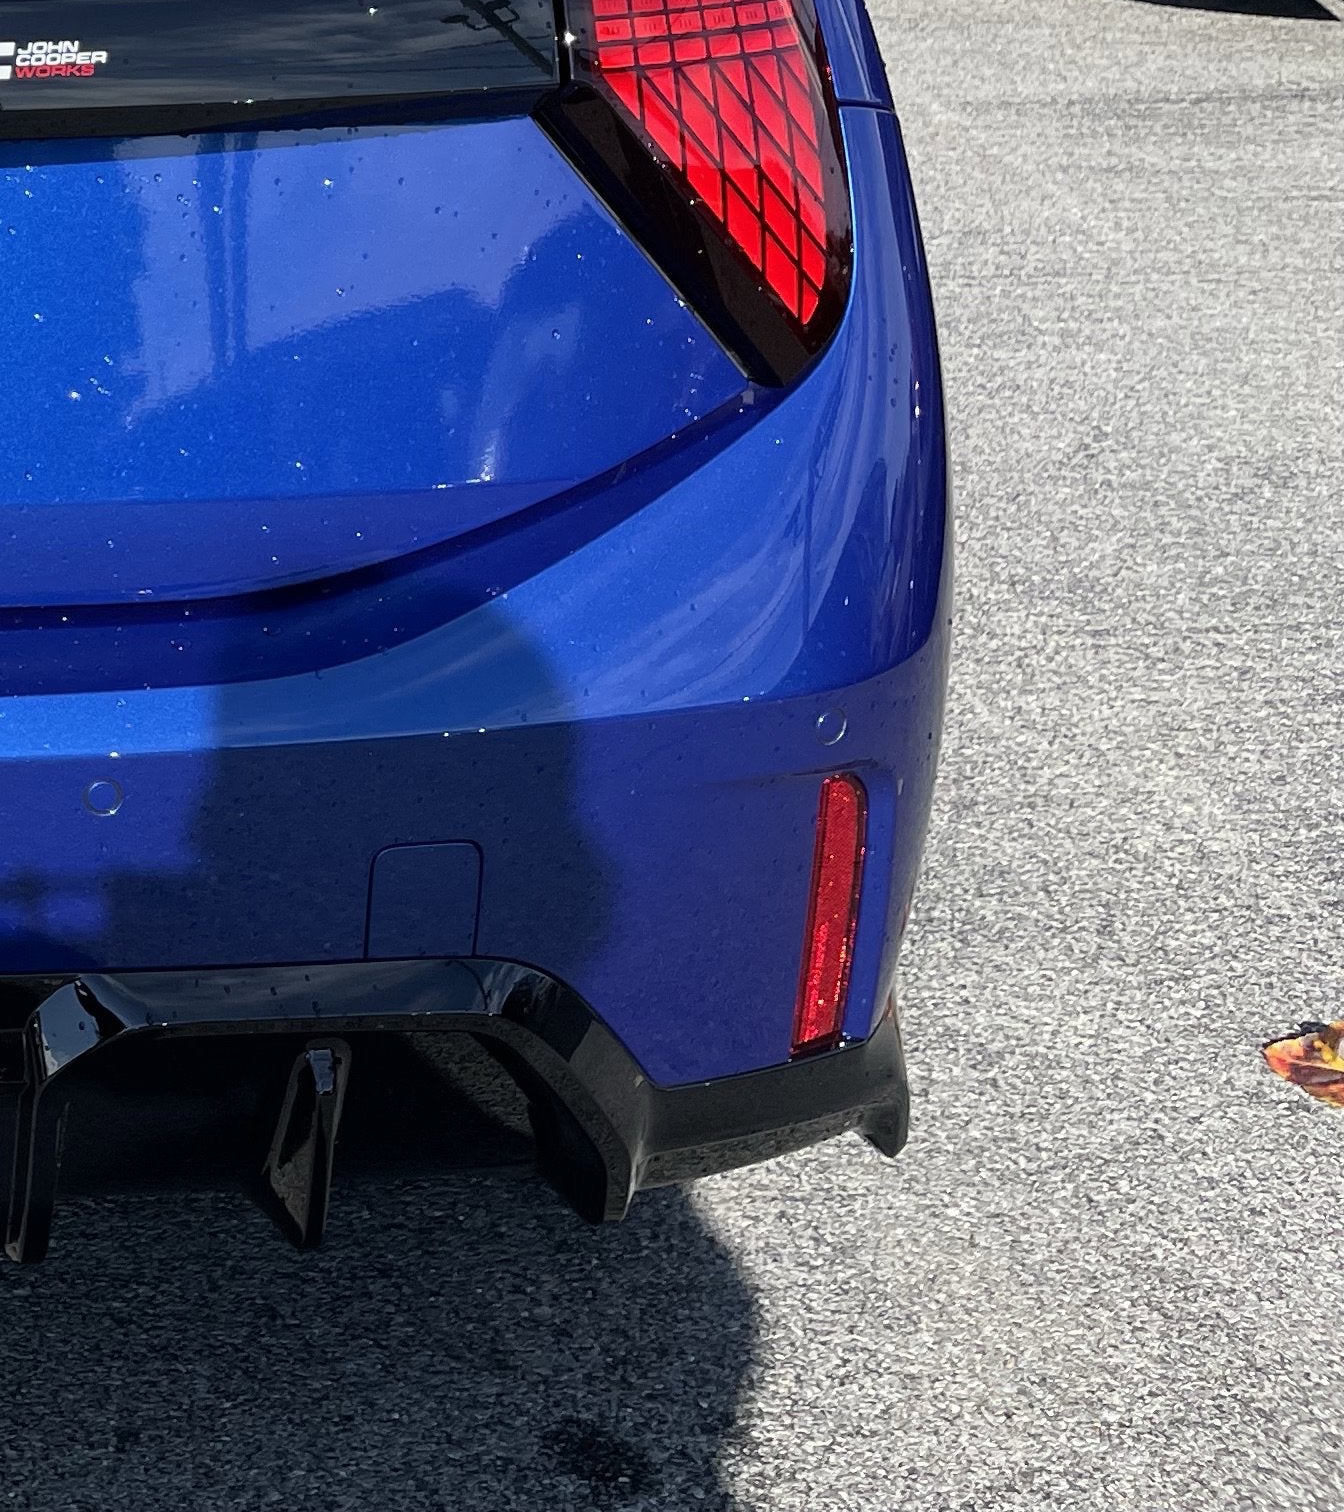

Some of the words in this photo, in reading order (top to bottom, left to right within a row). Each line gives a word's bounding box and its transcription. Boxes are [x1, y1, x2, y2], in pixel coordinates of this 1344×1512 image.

[18, 41, 79, 54] JOHN
[16, 51, 107, 66] COOPER
[16, 64, 94, 78] WORKS
